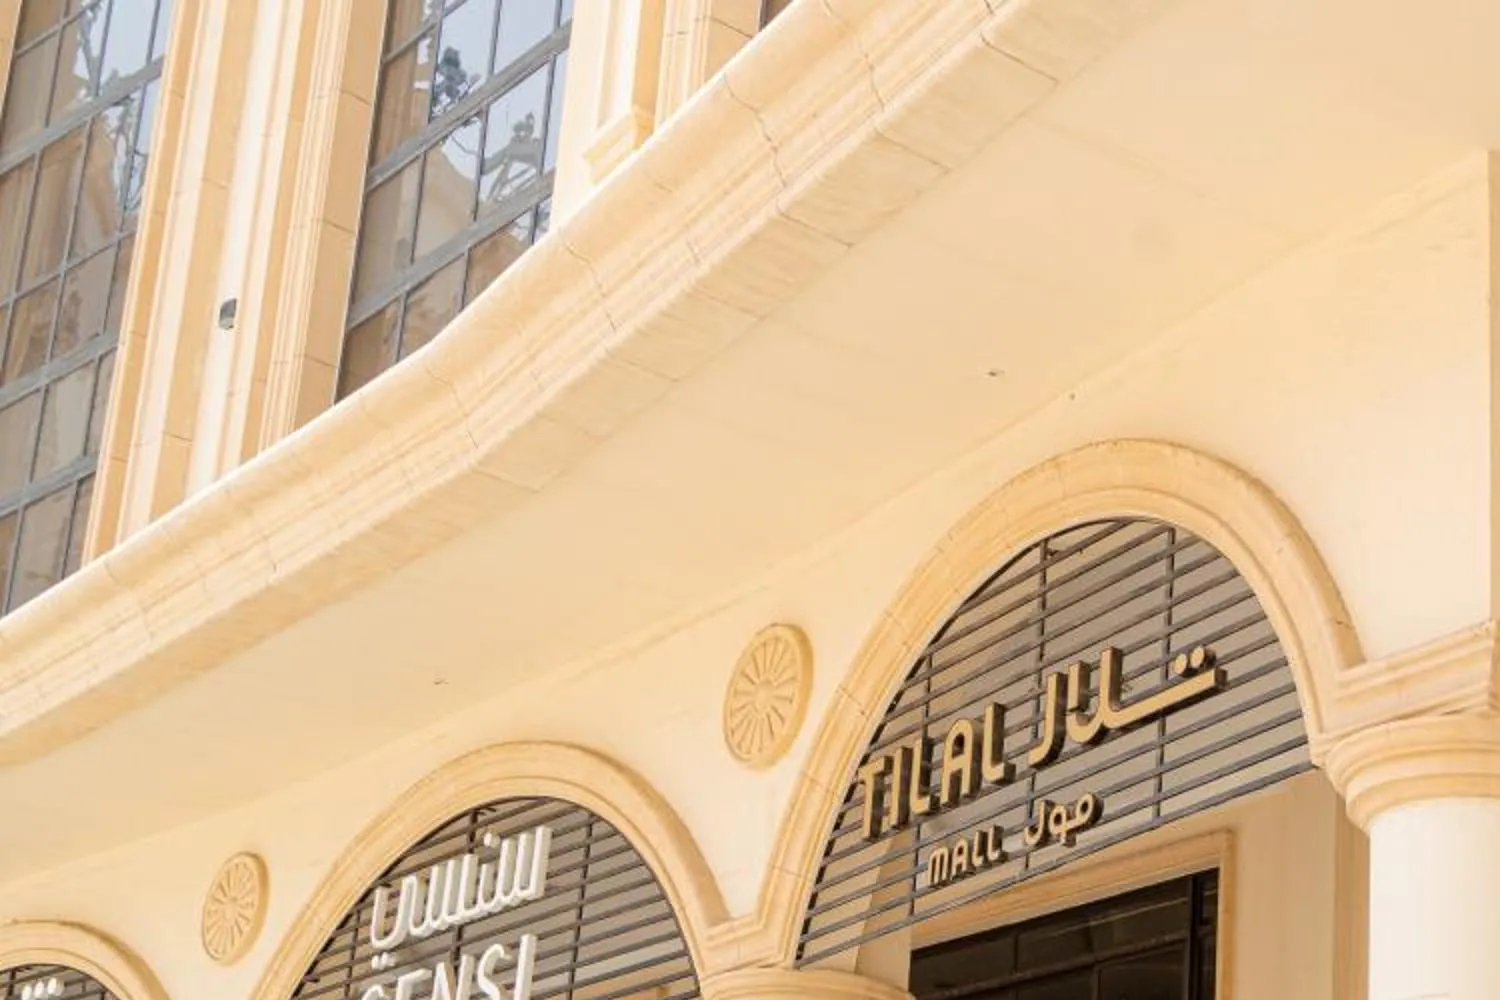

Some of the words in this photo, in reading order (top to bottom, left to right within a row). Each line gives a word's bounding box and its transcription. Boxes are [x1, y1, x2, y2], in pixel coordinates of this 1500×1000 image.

[859, 701, 1016, 842] TILAL
[927, 825, 1008, 888] MALL
[1024, 792, 1103, 848] مول
[369, 825, 552, 970] سنسي
